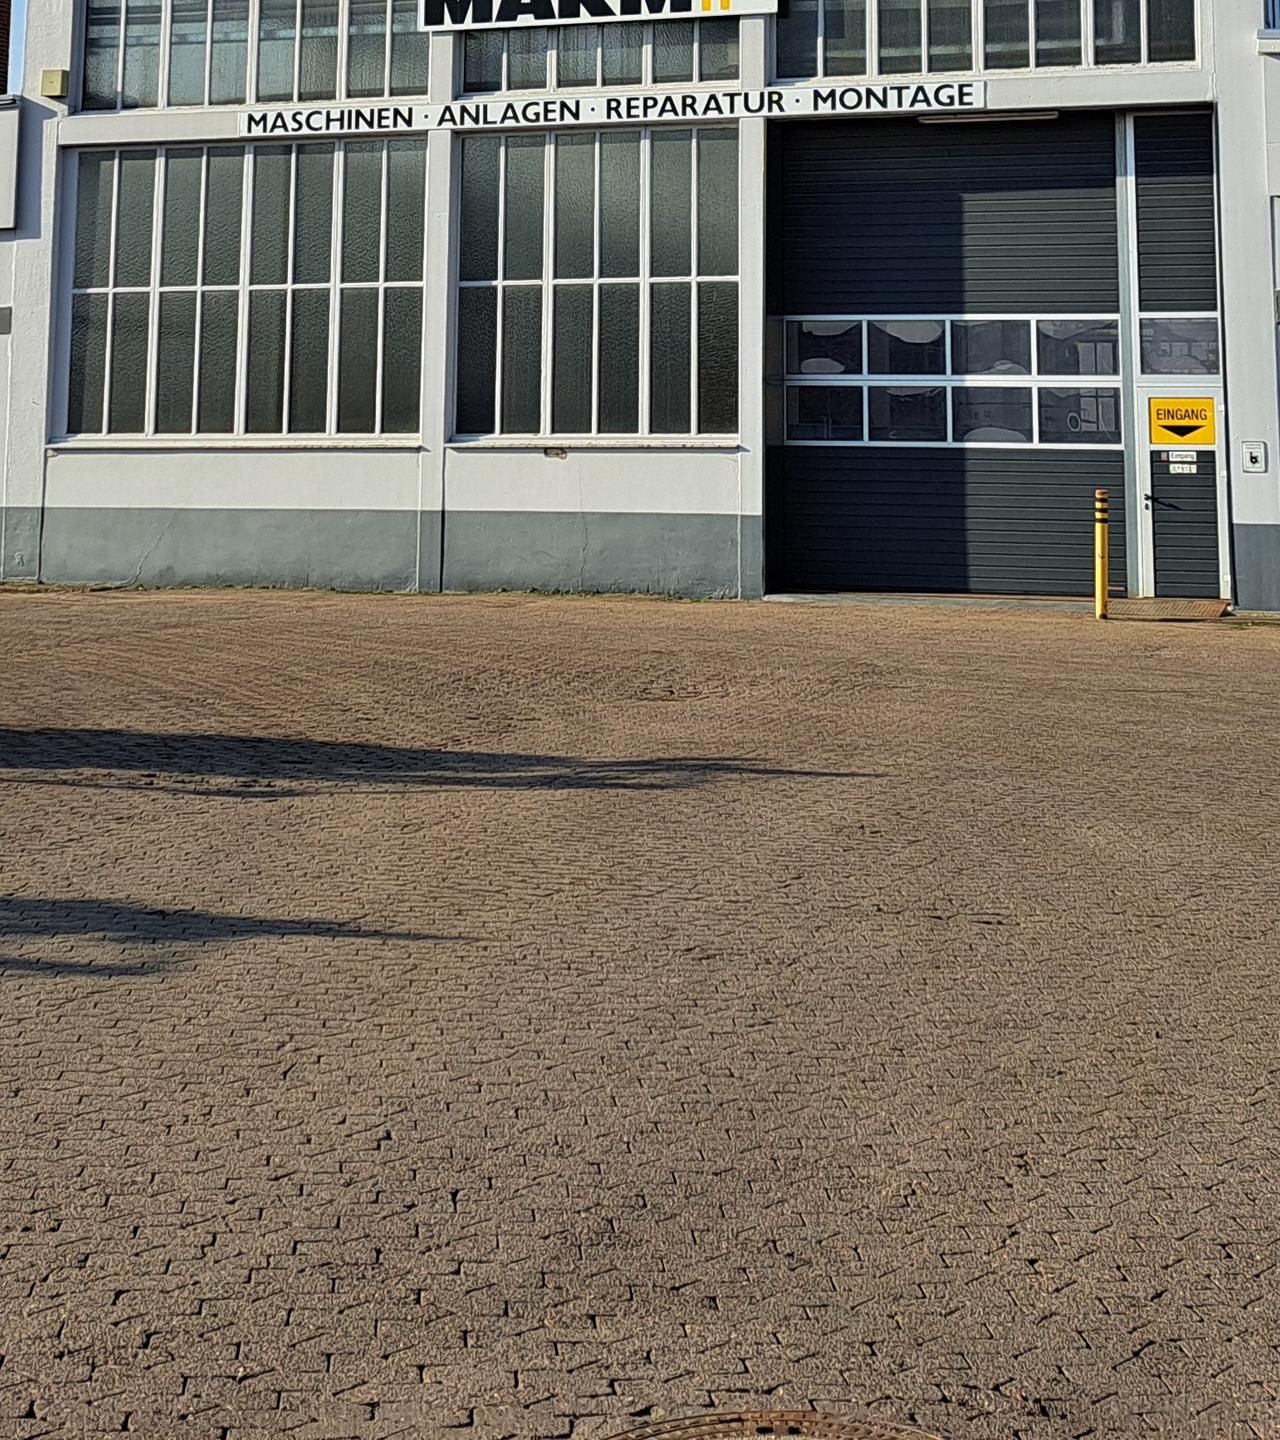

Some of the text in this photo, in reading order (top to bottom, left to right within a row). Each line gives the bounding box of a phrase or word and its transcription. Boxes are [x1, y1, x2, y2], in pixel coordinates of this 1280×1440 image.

[247, 83, 974, 134] MASCHINEN ANLAGEN REPARATUR MONTAGE
[1156, 408, 1207, 420] EINGANG
